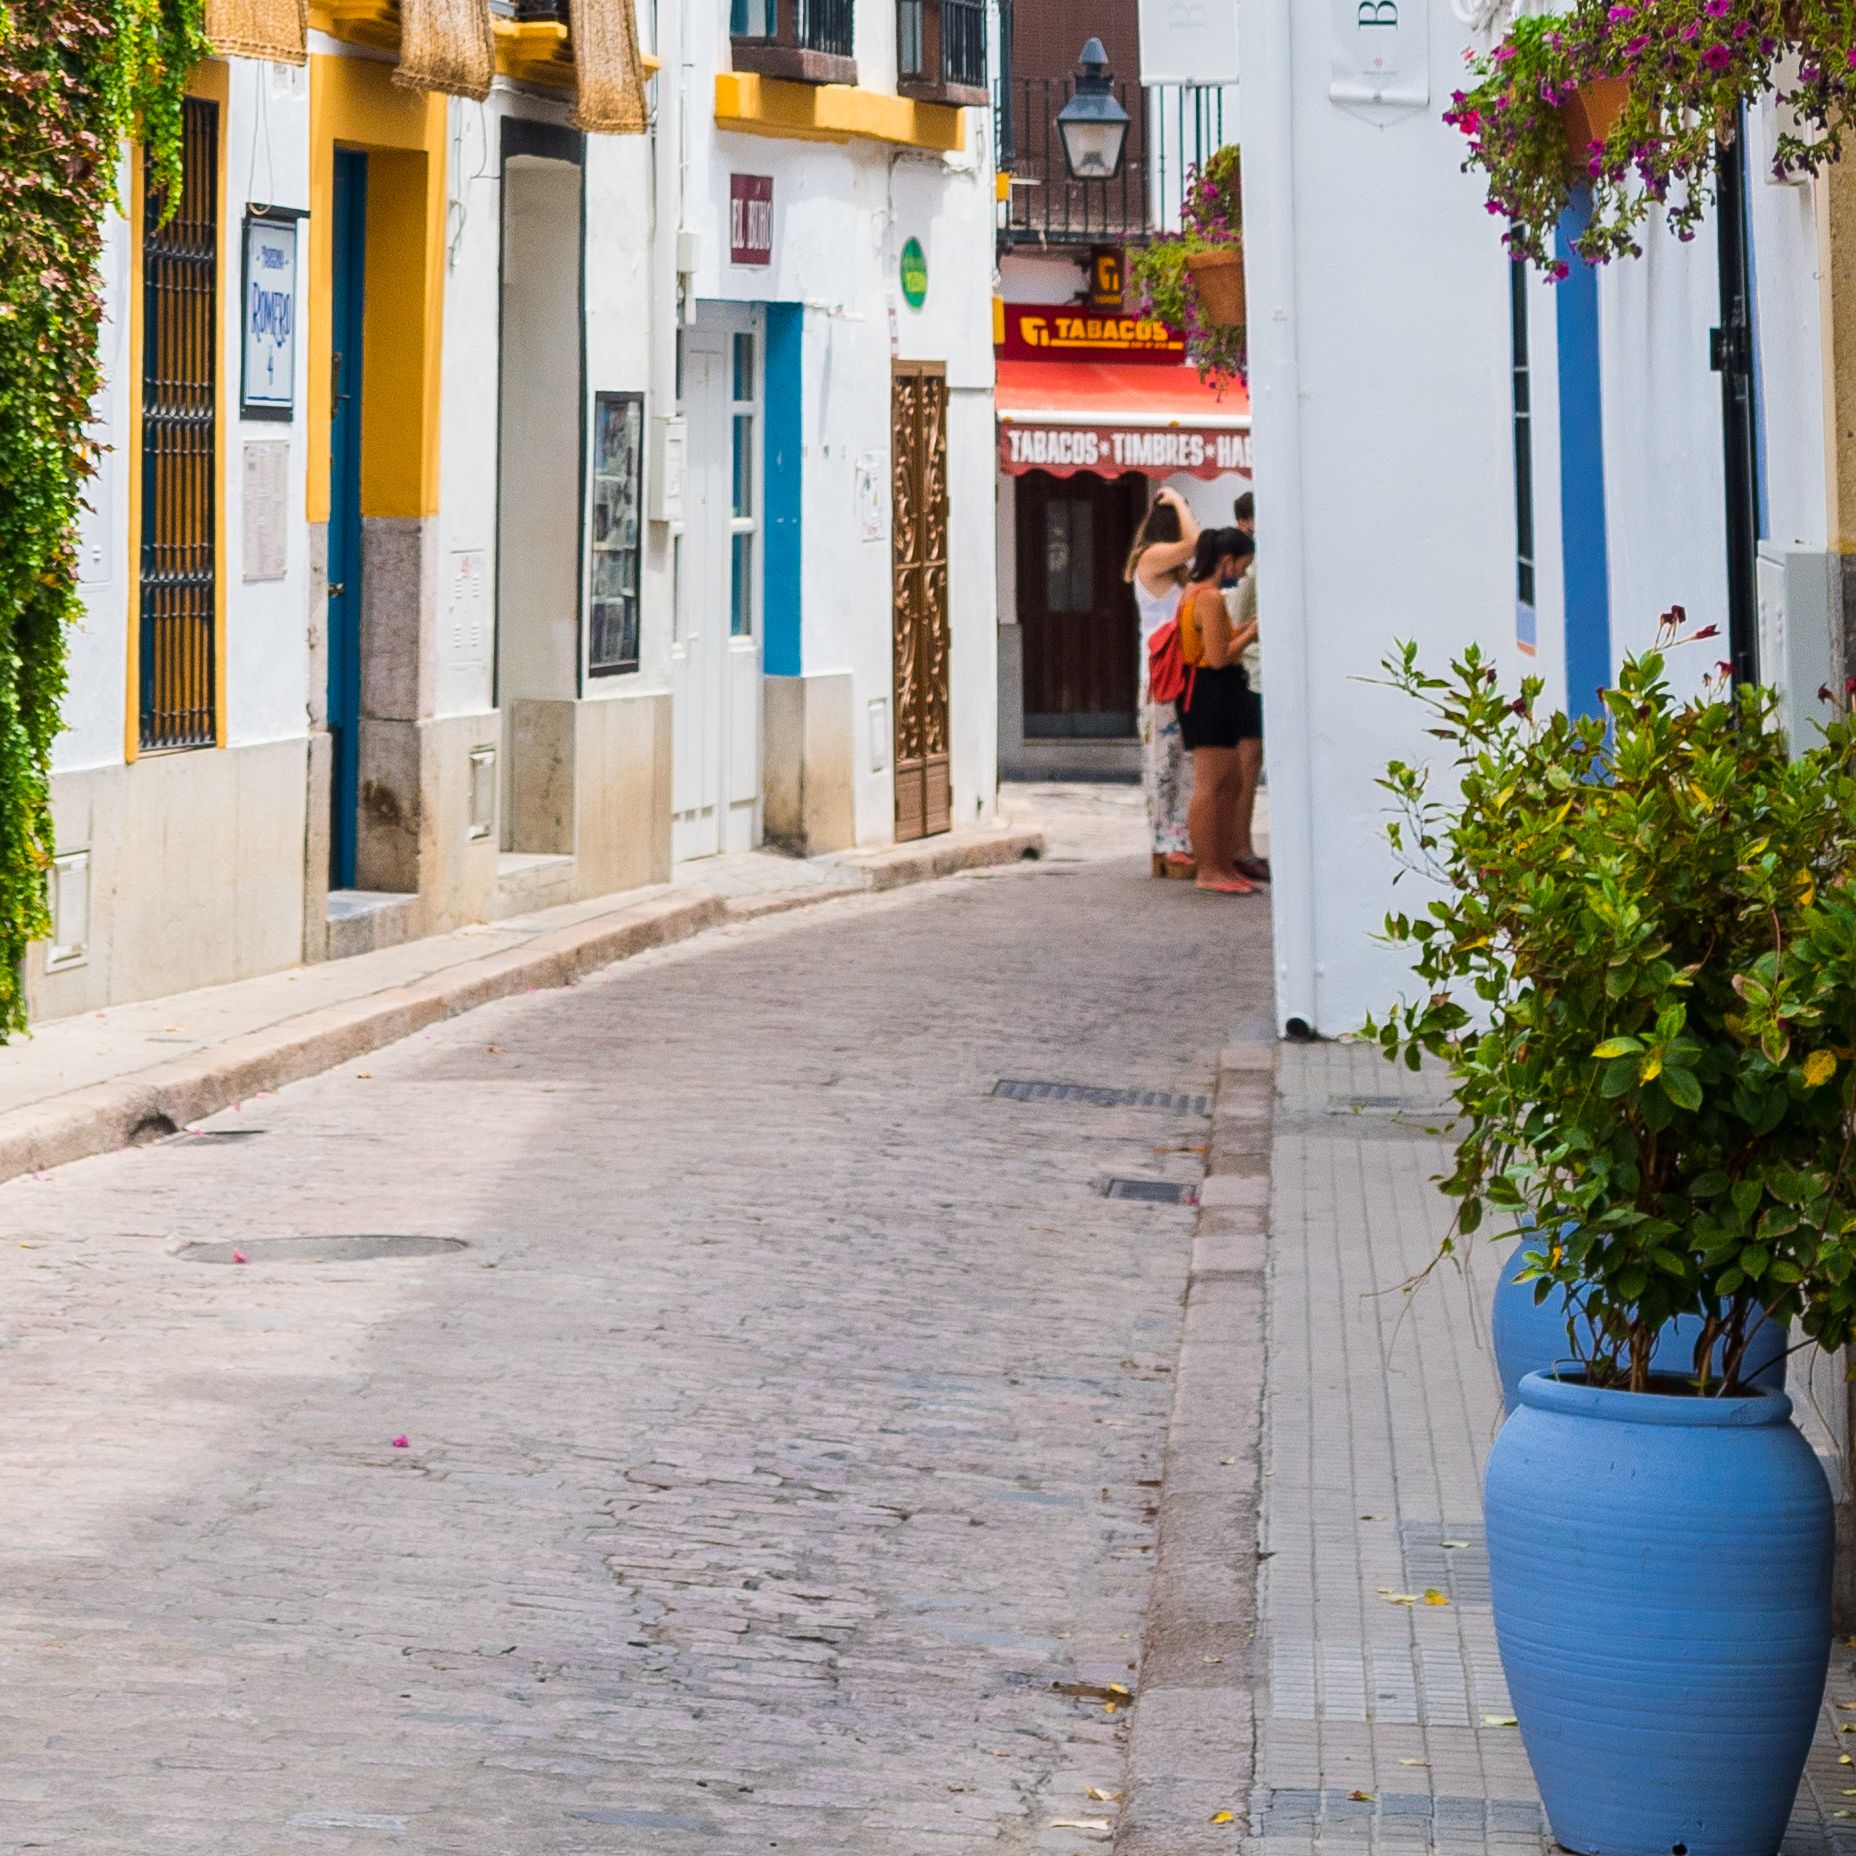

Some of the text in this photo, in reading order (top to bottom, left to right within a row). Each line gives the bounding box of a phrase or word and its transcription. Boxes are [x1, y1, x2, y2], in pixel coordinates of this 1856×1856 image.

[250, 281, 292, 349] ROMERO
[1055, 318, 1168, 341] TABACOS
[1007, 430, 1099, 464] TABACOS
[1111, 432, 1204, 466] TIMBRES
